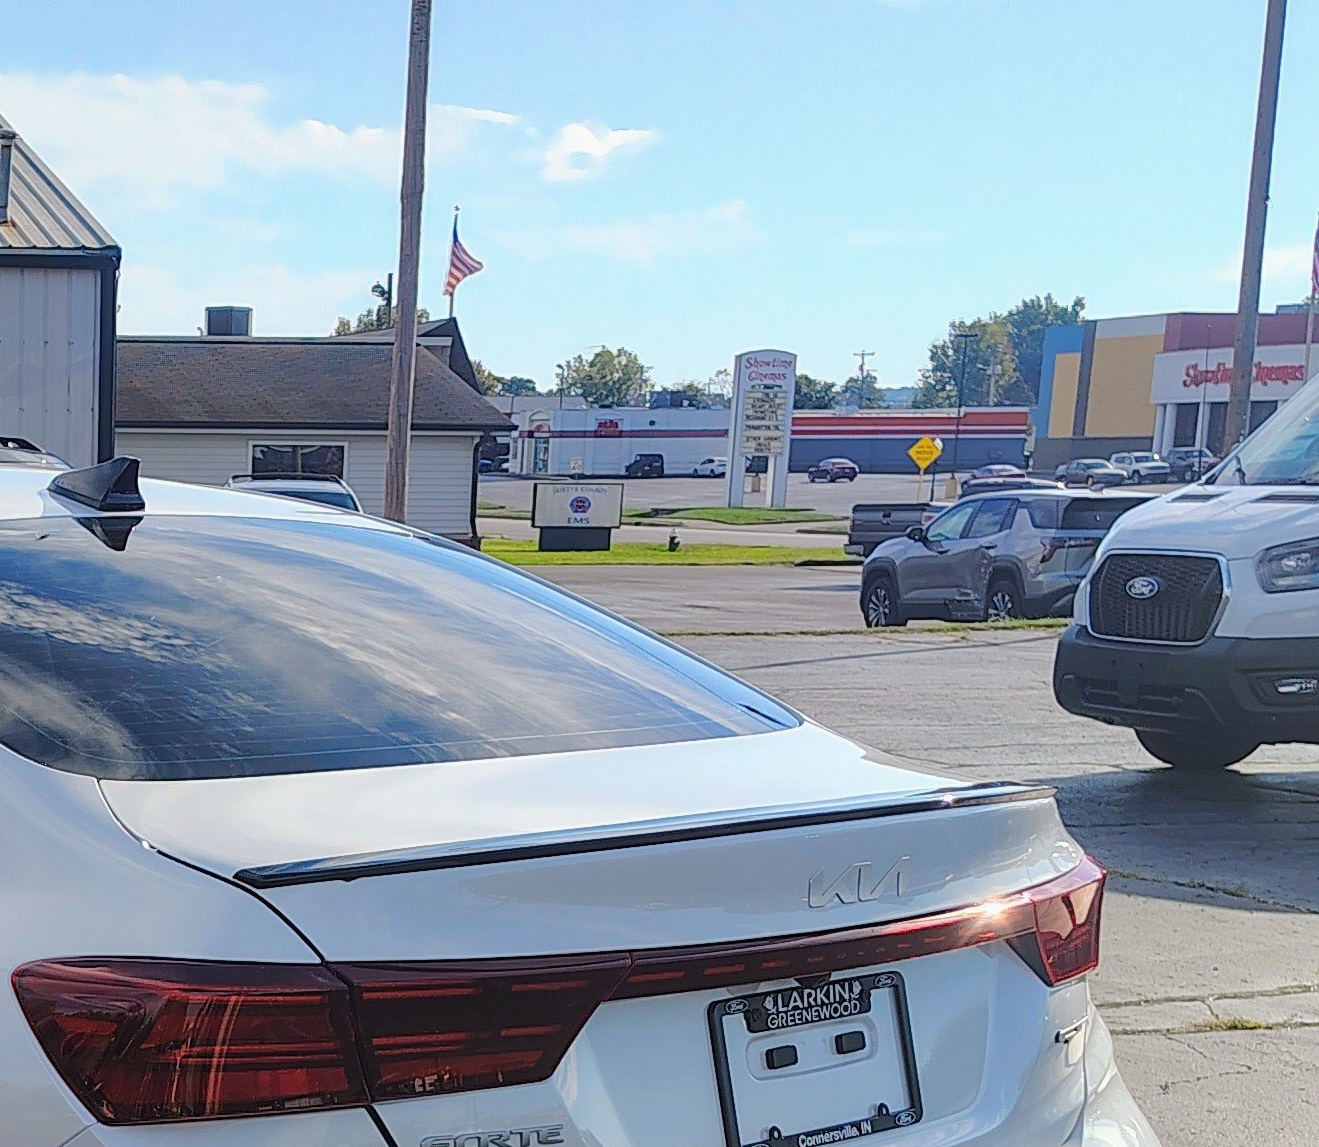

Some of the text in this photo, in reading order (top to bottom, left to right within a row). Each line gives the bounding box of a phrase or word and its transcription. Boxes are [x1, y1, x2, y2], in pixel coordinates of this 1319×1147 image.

[777, 981, 850, 1012] LARKIN
[767, 1000, 860, 1029] GREENEWOOD
[798, 1120, 872, 1147] Connersville, IN
